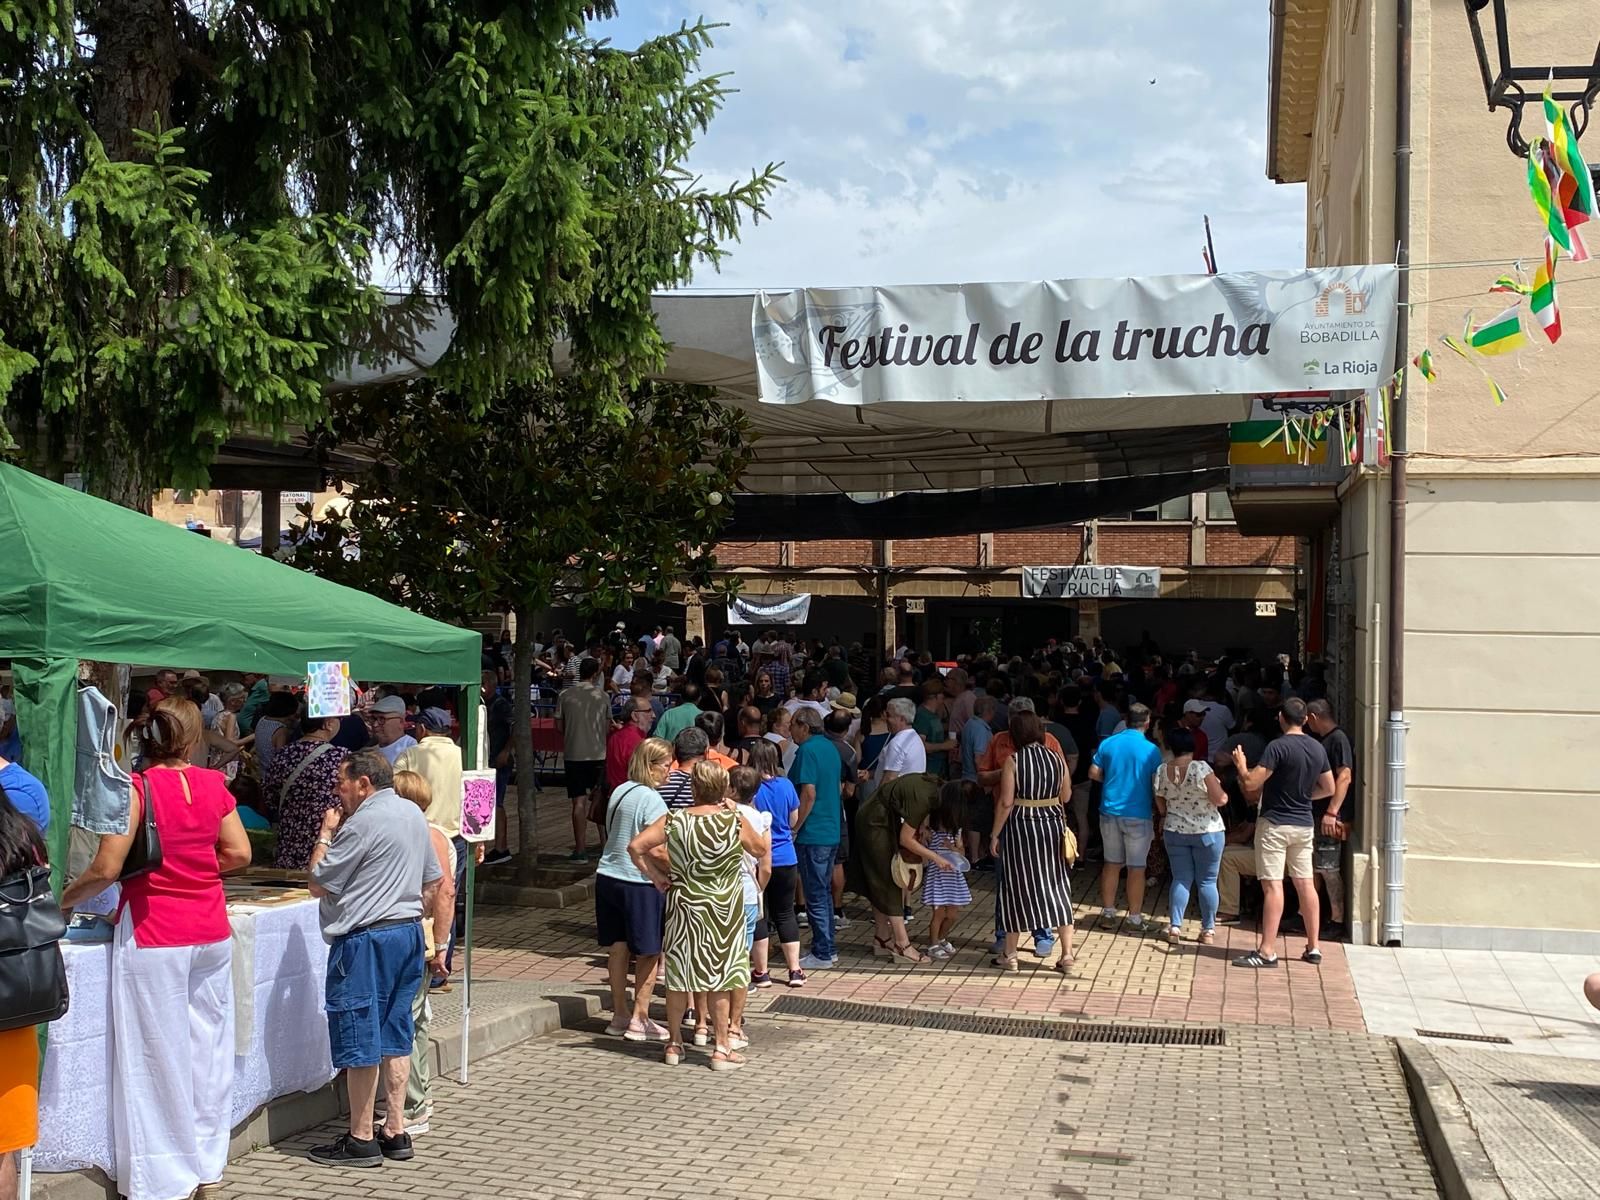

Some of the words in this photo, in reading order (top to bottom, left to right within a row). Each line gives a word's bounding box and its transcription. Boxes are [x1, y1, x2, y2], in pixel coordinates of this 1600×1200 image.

[1304, 321, 1363, 329] AYUNTAMIENTO
[1365, 320, 1375, 328] DE
[818, 322, 980, 370] Festival
[988, 321, 1044, 365] de
[1054, 319, 1101, 363] la
[1112, 312, 1272, 361] trucha
[1300, 330, 1380, 344] BOBADILLA
[1324, 362, 1339, 375] La
[1342, 360, 1378, 375] Rioja
[1031, 567, 1098, 580] FESTIVAL
[1104, 567, 1122, 580] DE
[1058, 582, 1122, 596] TRUCHA
